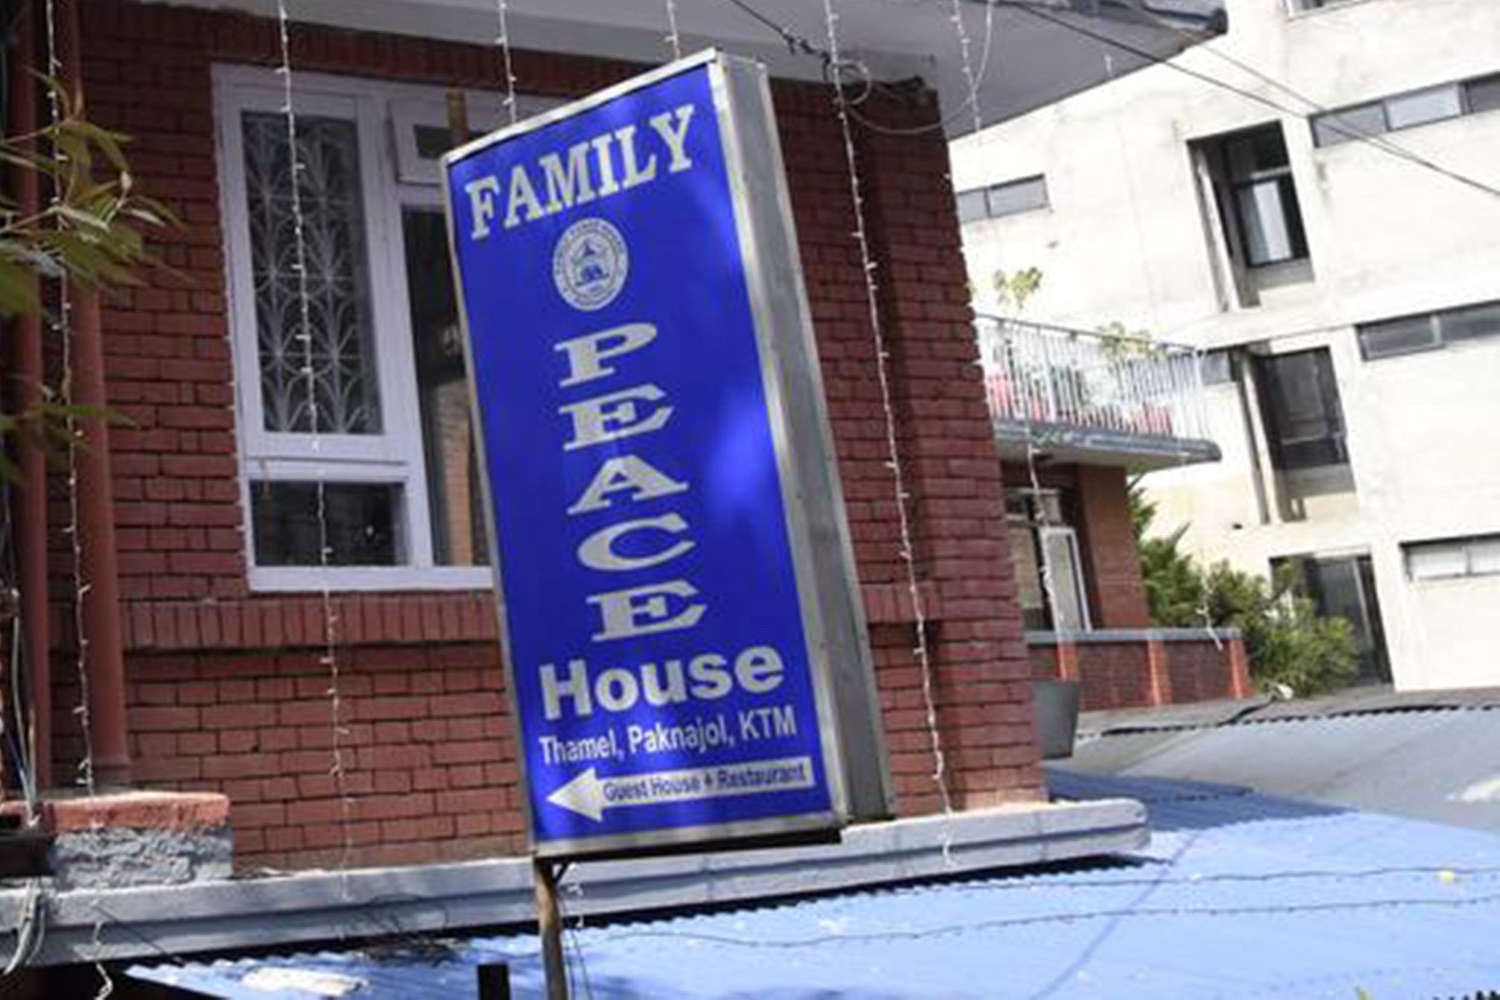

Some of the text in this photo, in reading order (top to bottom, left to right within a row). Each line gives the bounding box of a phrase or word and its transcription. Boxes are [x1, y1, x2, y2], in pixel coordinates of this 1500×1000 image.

[465, 104, 695, 240] FAMILY
[554, 322, 707, 642] PEACE
[540, 645, 784, 720] House
[540, 705, 796, 765] Thamel, Paknajol, KTM
[604, 780, 648, 801] Guest
[651, 772, 700, 796] House
[716, 762, 806, 791] Restaurant
